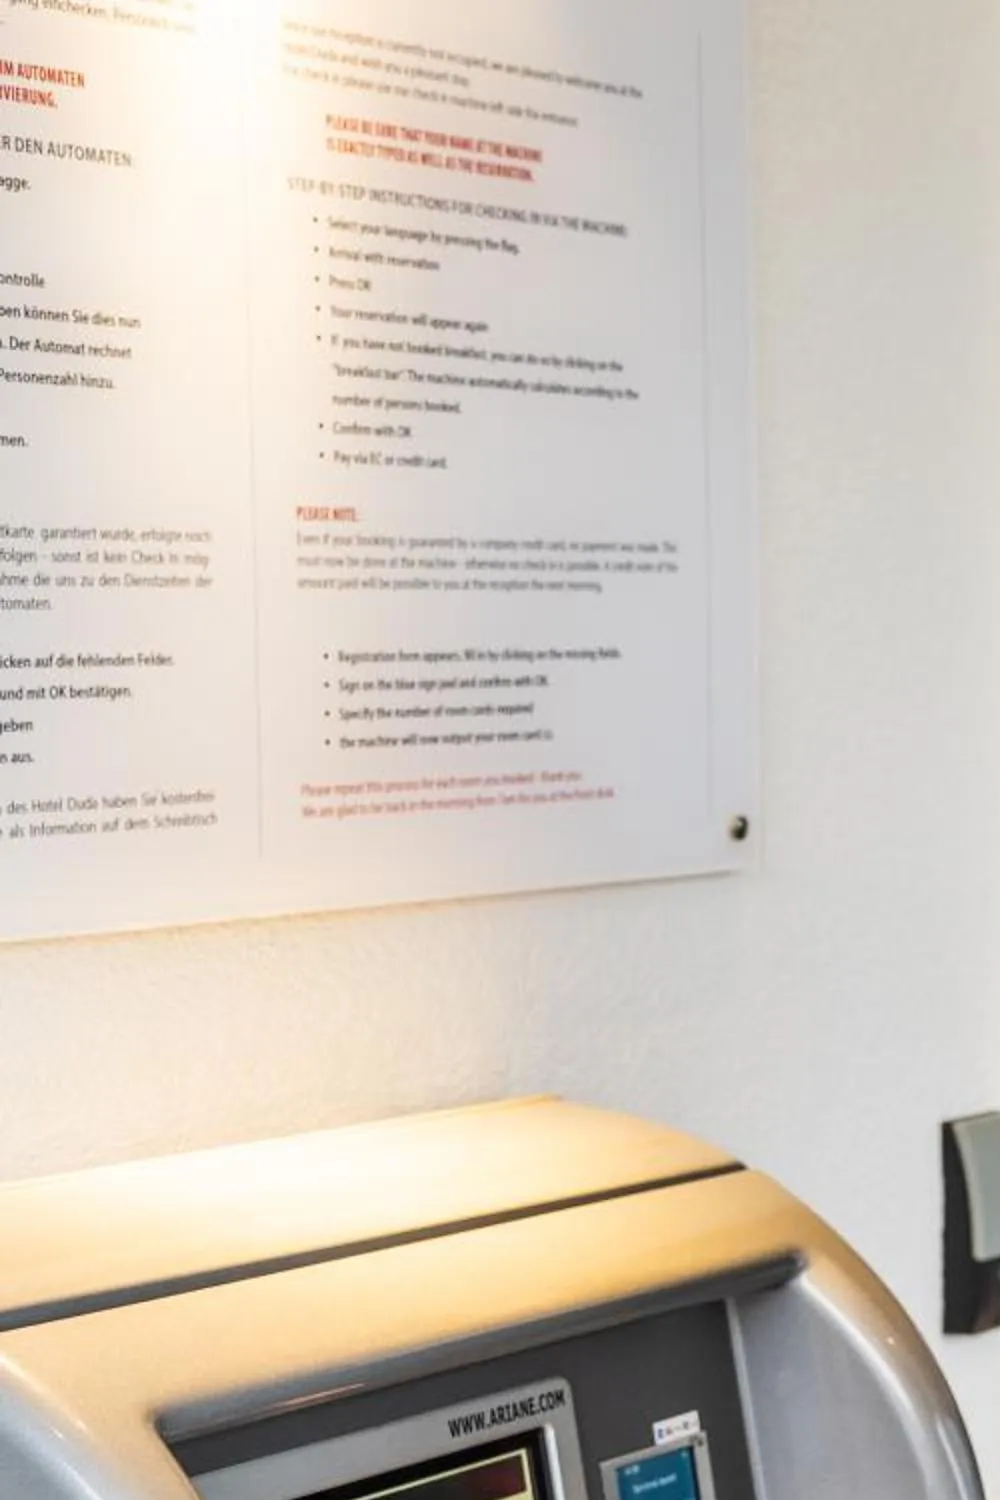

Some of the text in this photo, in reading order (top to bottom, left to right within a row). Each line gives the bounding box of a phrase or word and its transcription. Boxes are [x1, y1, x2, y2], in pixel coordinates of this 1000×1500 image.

[17, 62, 84, 87] AUTOMATEN
[15, 137, 42, 154] DEN
[23, 305, 68, 322] können
[9, 336, 131, 358] Der Automat rechnet
[26, 685, 45, 699] mit
[49, 685, 67, 698] OK
[448, 1389, 566, 1438] WWW.ARIANE.COM
